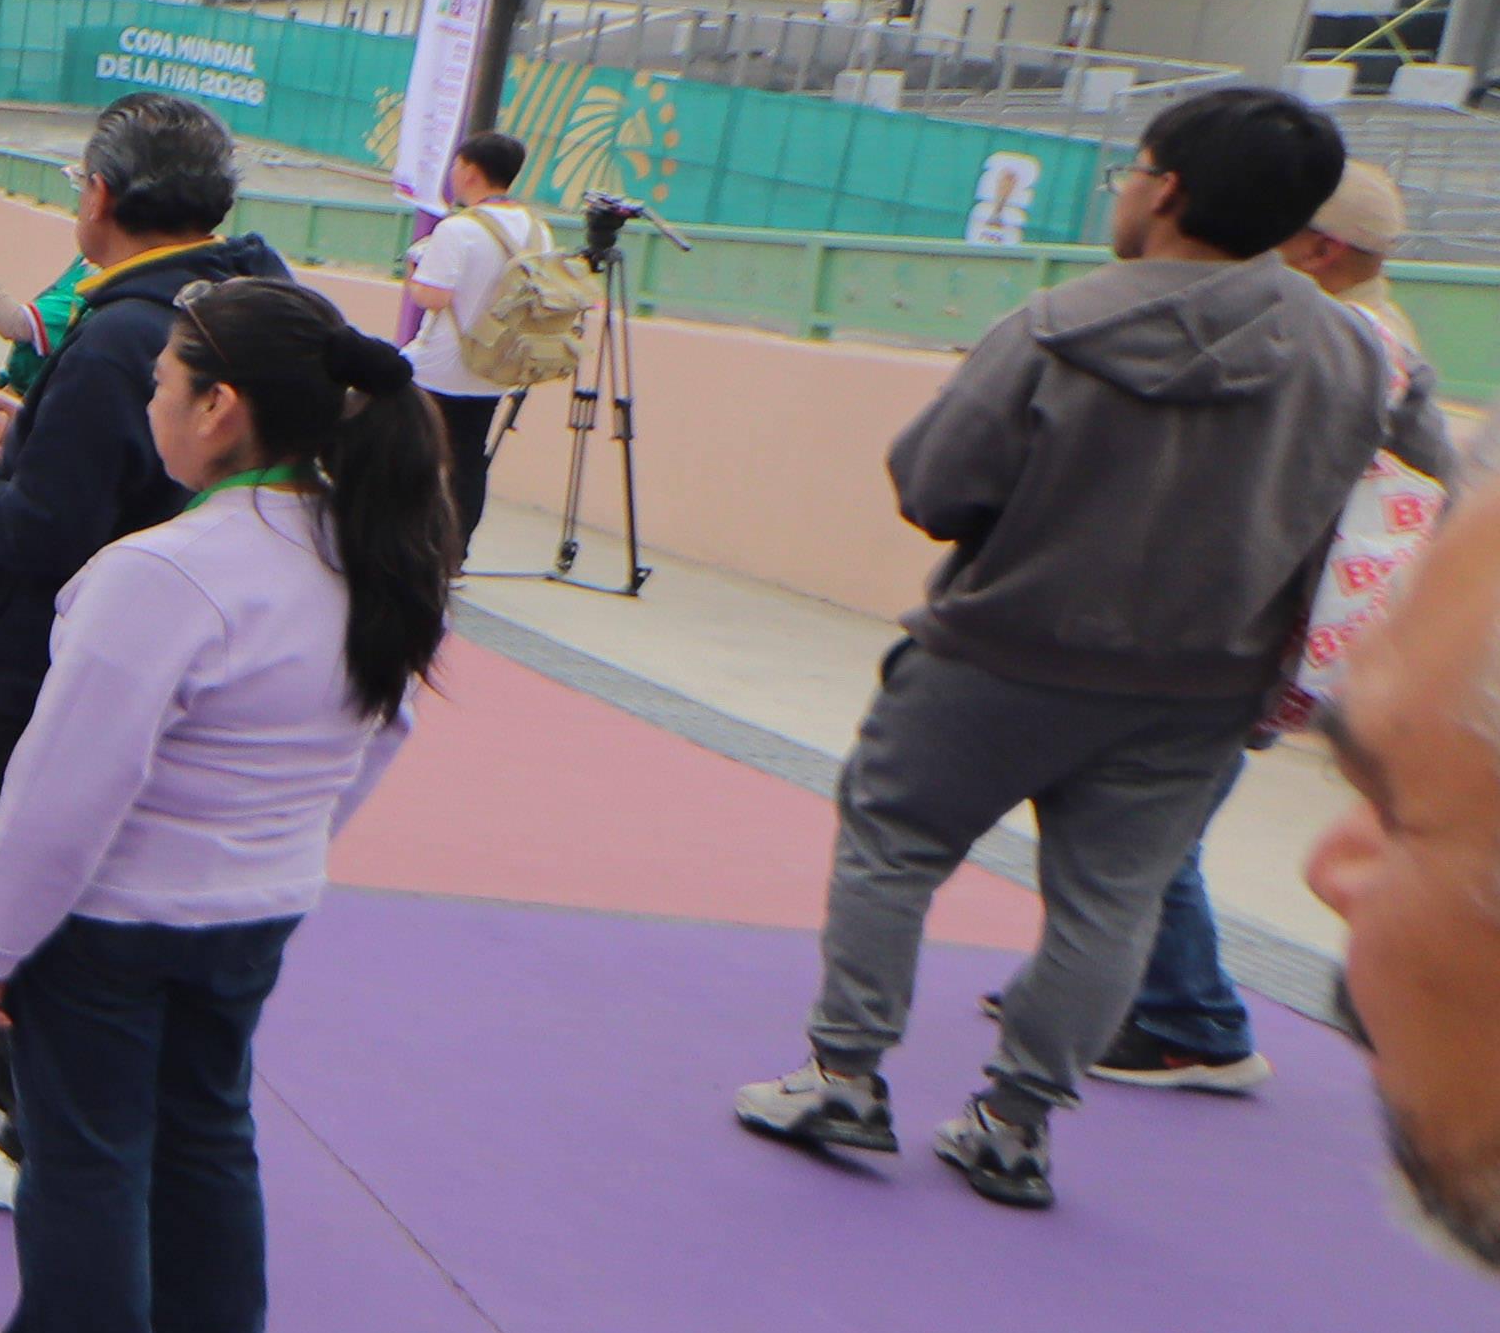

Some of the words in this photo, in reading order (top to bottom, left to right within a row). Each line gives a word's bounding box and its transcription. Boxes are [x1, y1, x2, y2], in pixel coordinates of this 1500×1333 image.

[118, 26, 175, 59] COPA
[174, 34, 256, 73] MUNDIAL
[95, 53, 133, 80] DE
[133, 56, 158, 85] LA
[160, 61, 200, 93] FIFA
[199, 68, 266, 106] 2026
